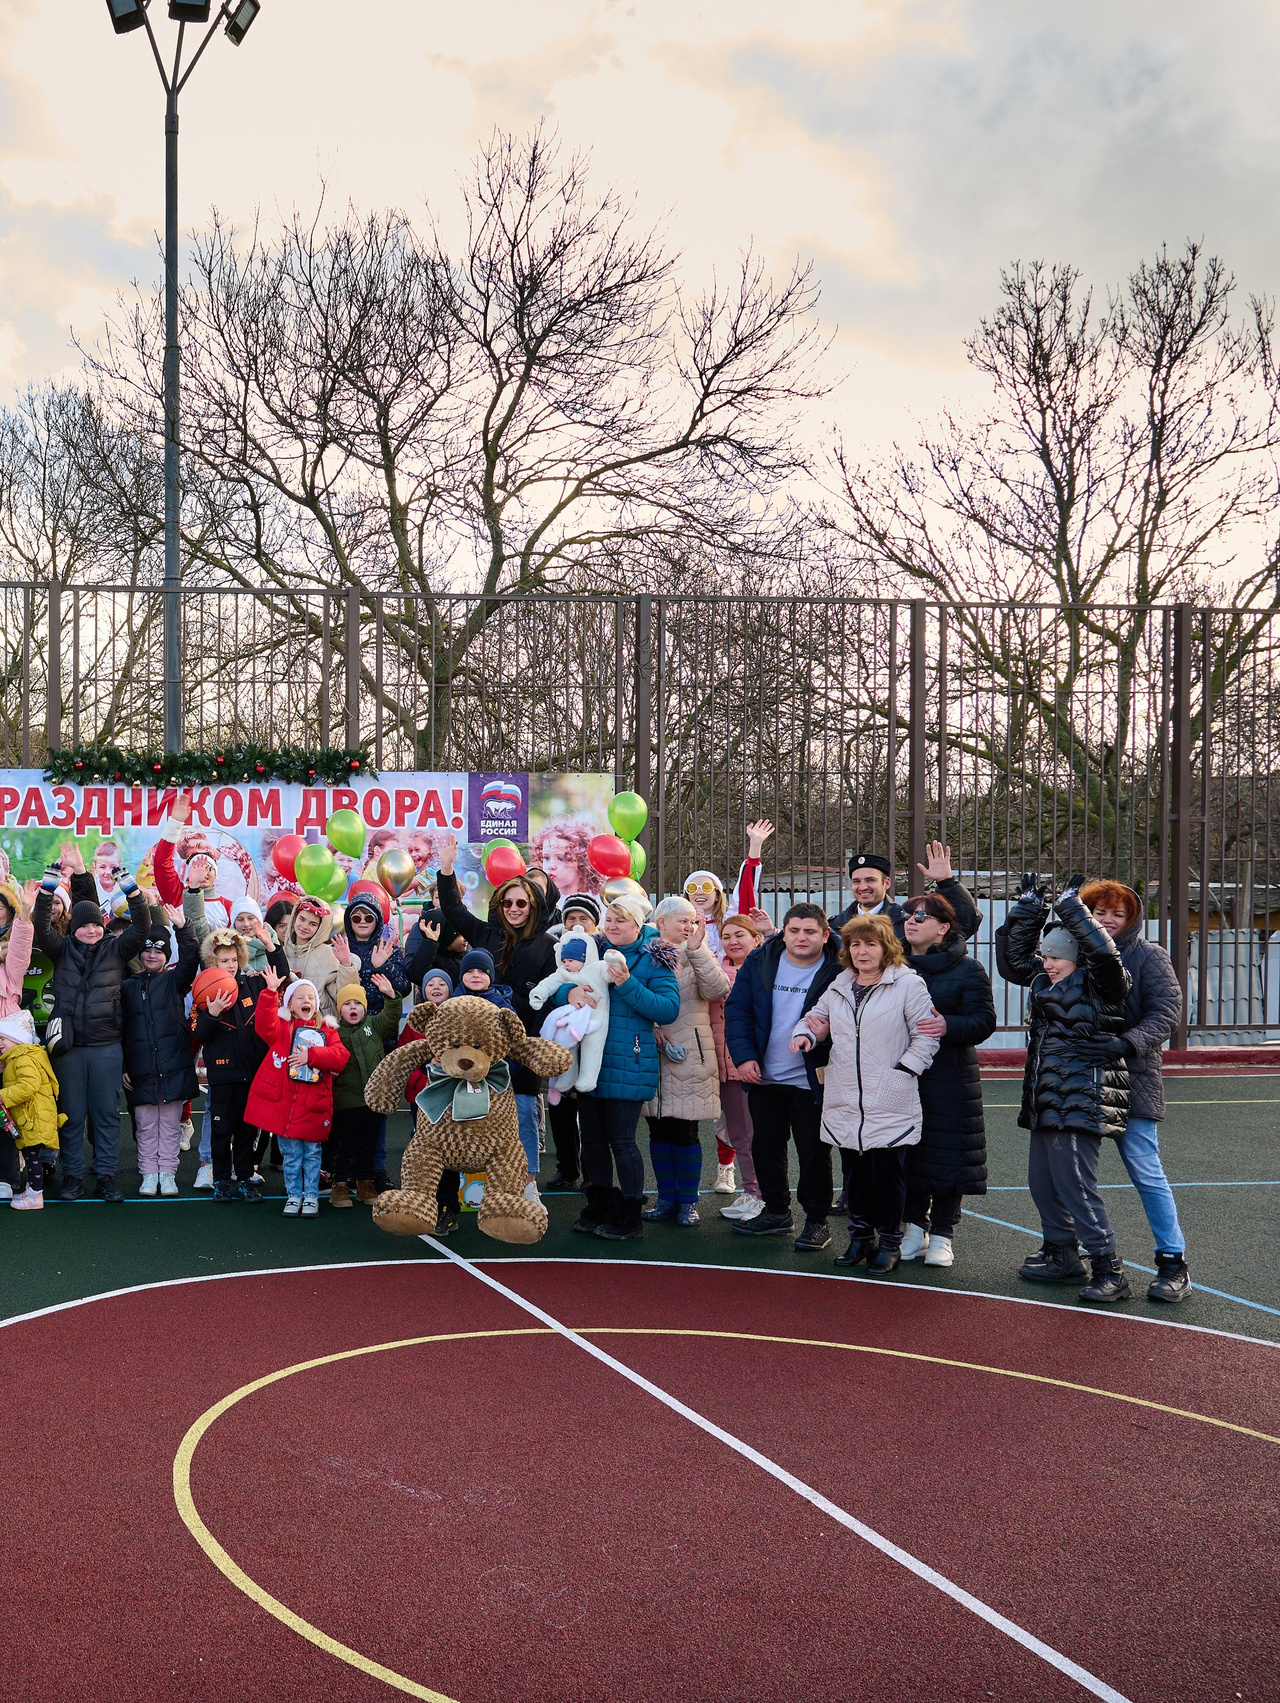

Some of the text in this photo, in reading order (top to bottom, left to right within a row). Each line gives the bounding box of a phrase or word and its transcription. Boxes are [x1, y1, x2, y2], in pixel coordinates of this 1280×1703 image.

[295, 788, 464, 835] ДВОРА!
[480, 820, 517, 828] ЕДИНАЯ
[480, 827, 517, 835] РОССИЯ
[24, 966, 42, 975] rds
